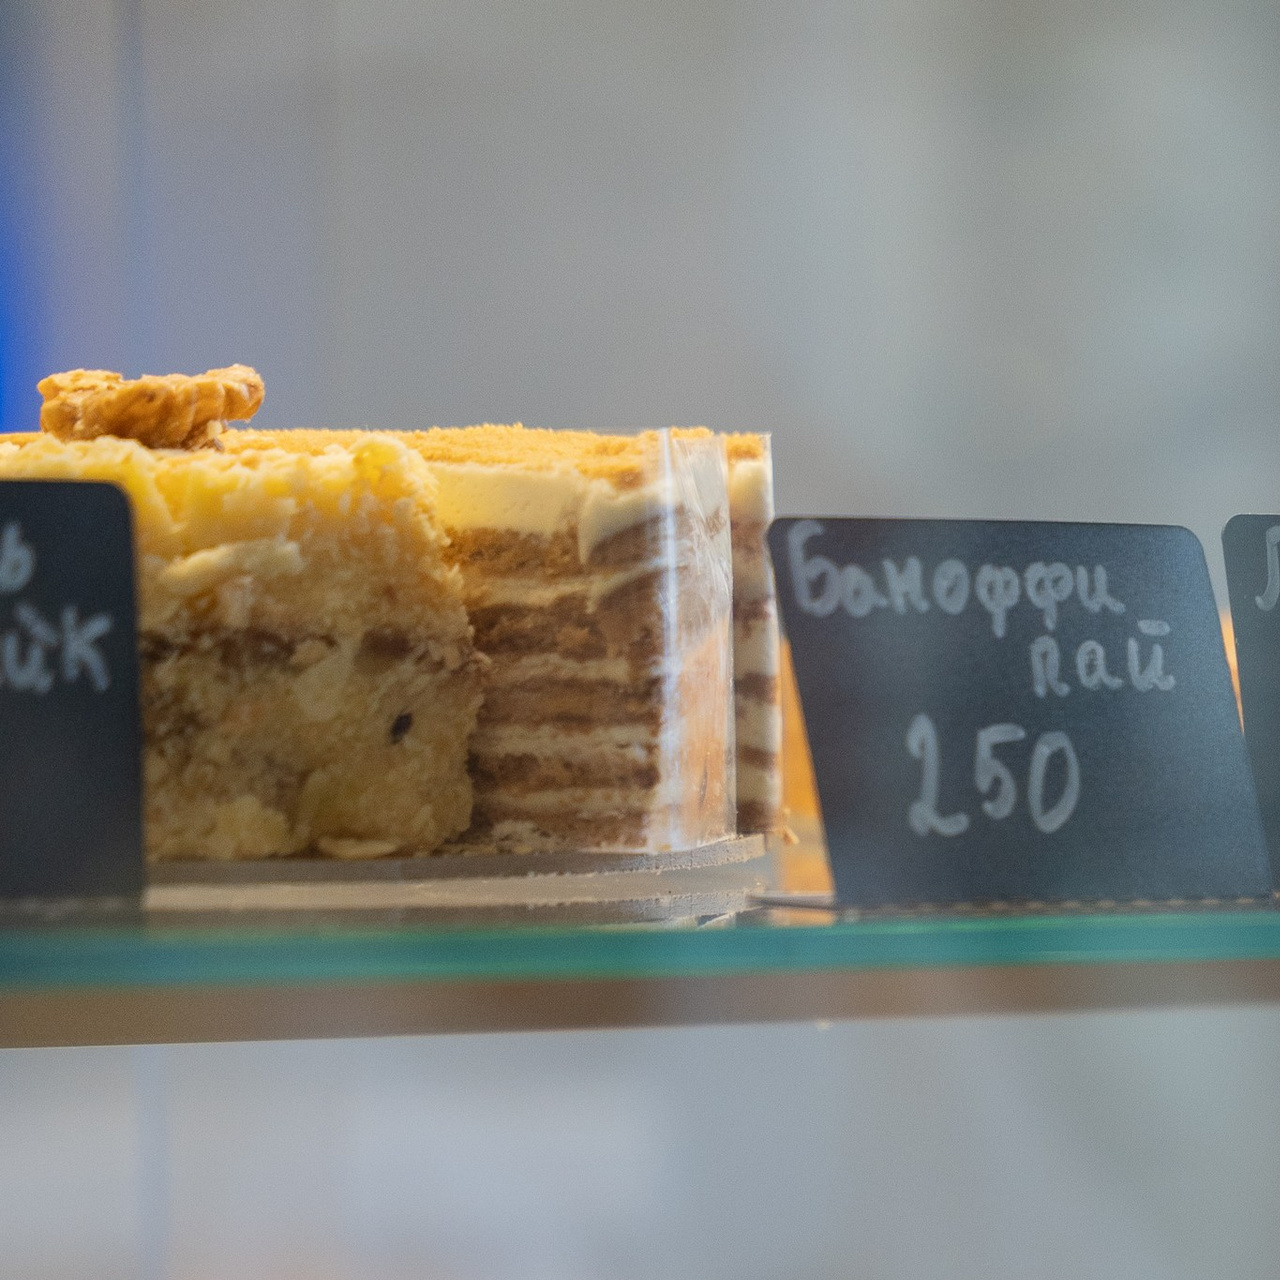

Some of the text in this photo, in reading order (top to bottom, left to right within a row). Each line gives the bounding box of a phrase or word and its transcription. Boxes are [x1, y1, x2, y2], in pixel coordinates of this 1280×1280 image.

[787, 519, 1126, 638] Баноффи
[1030, 619, 1176, 698] пай
[906, 713, 1081, 837] 250
